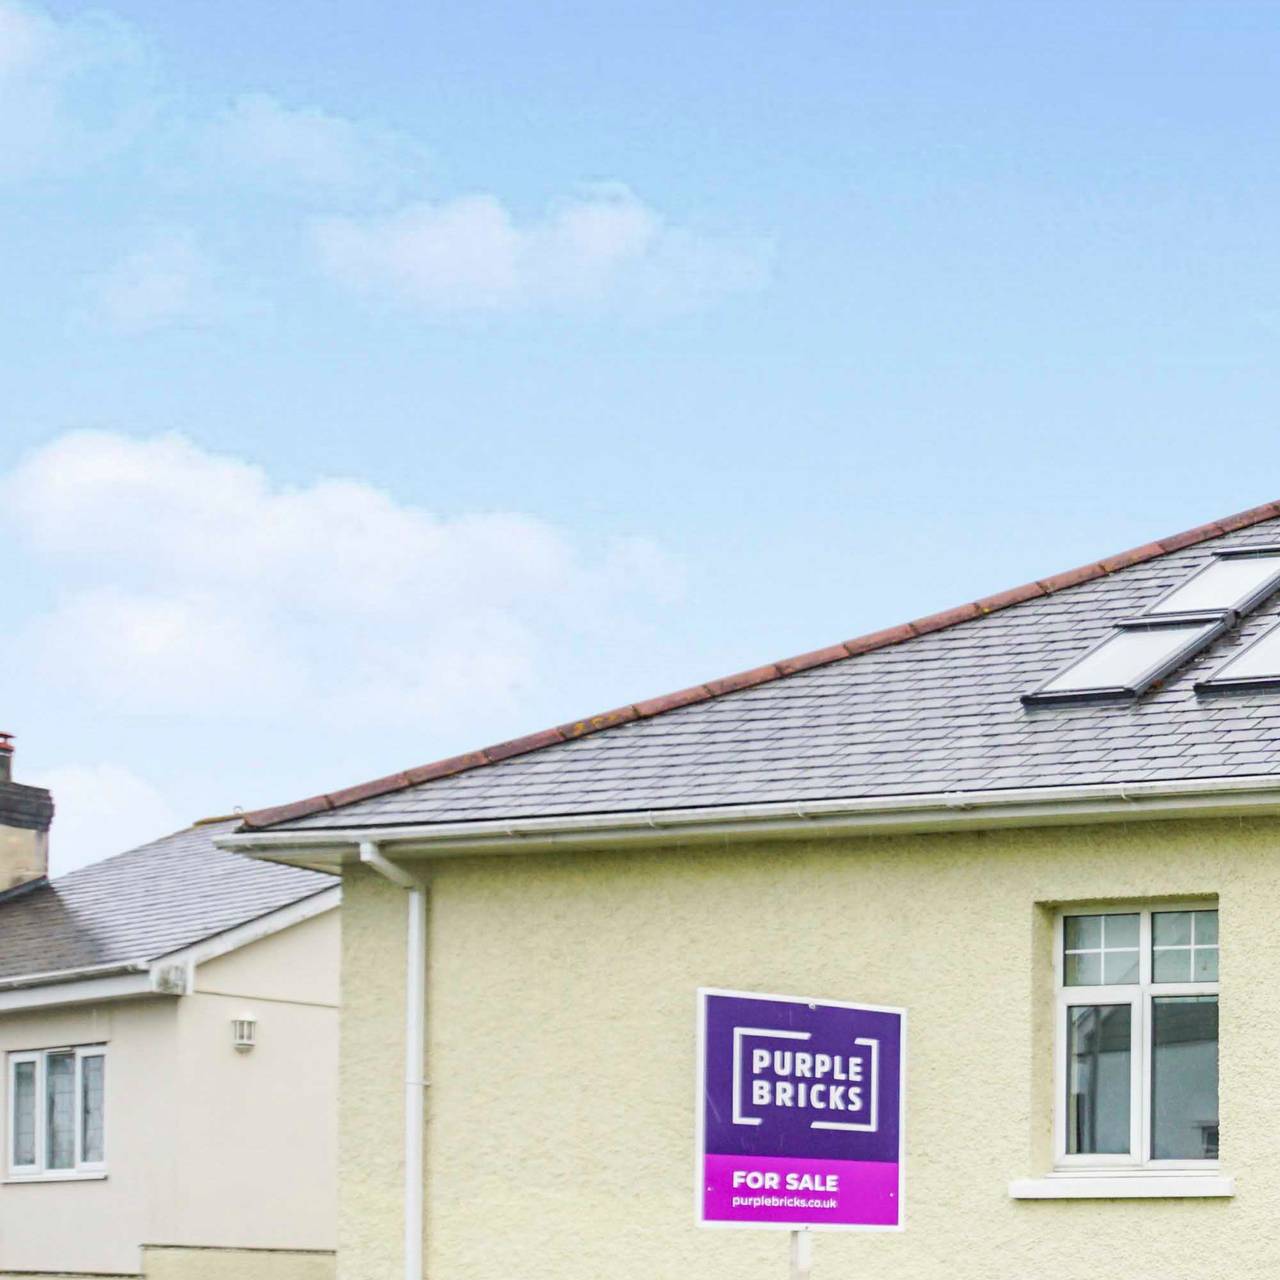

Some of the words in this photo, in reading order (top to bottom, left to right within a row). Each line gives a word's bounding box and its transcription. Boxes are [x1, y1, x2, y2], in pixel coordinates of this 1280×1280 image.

[752, 1048, 863, 1082] PURPLE
[752, 1079, 863, 1112] BRICKS
[732, 1171, 780, 1189] FOR
[785, 1173, 839, 1191] SALE
[732, 1195, 837, 1209] purplebricks.co.uk
